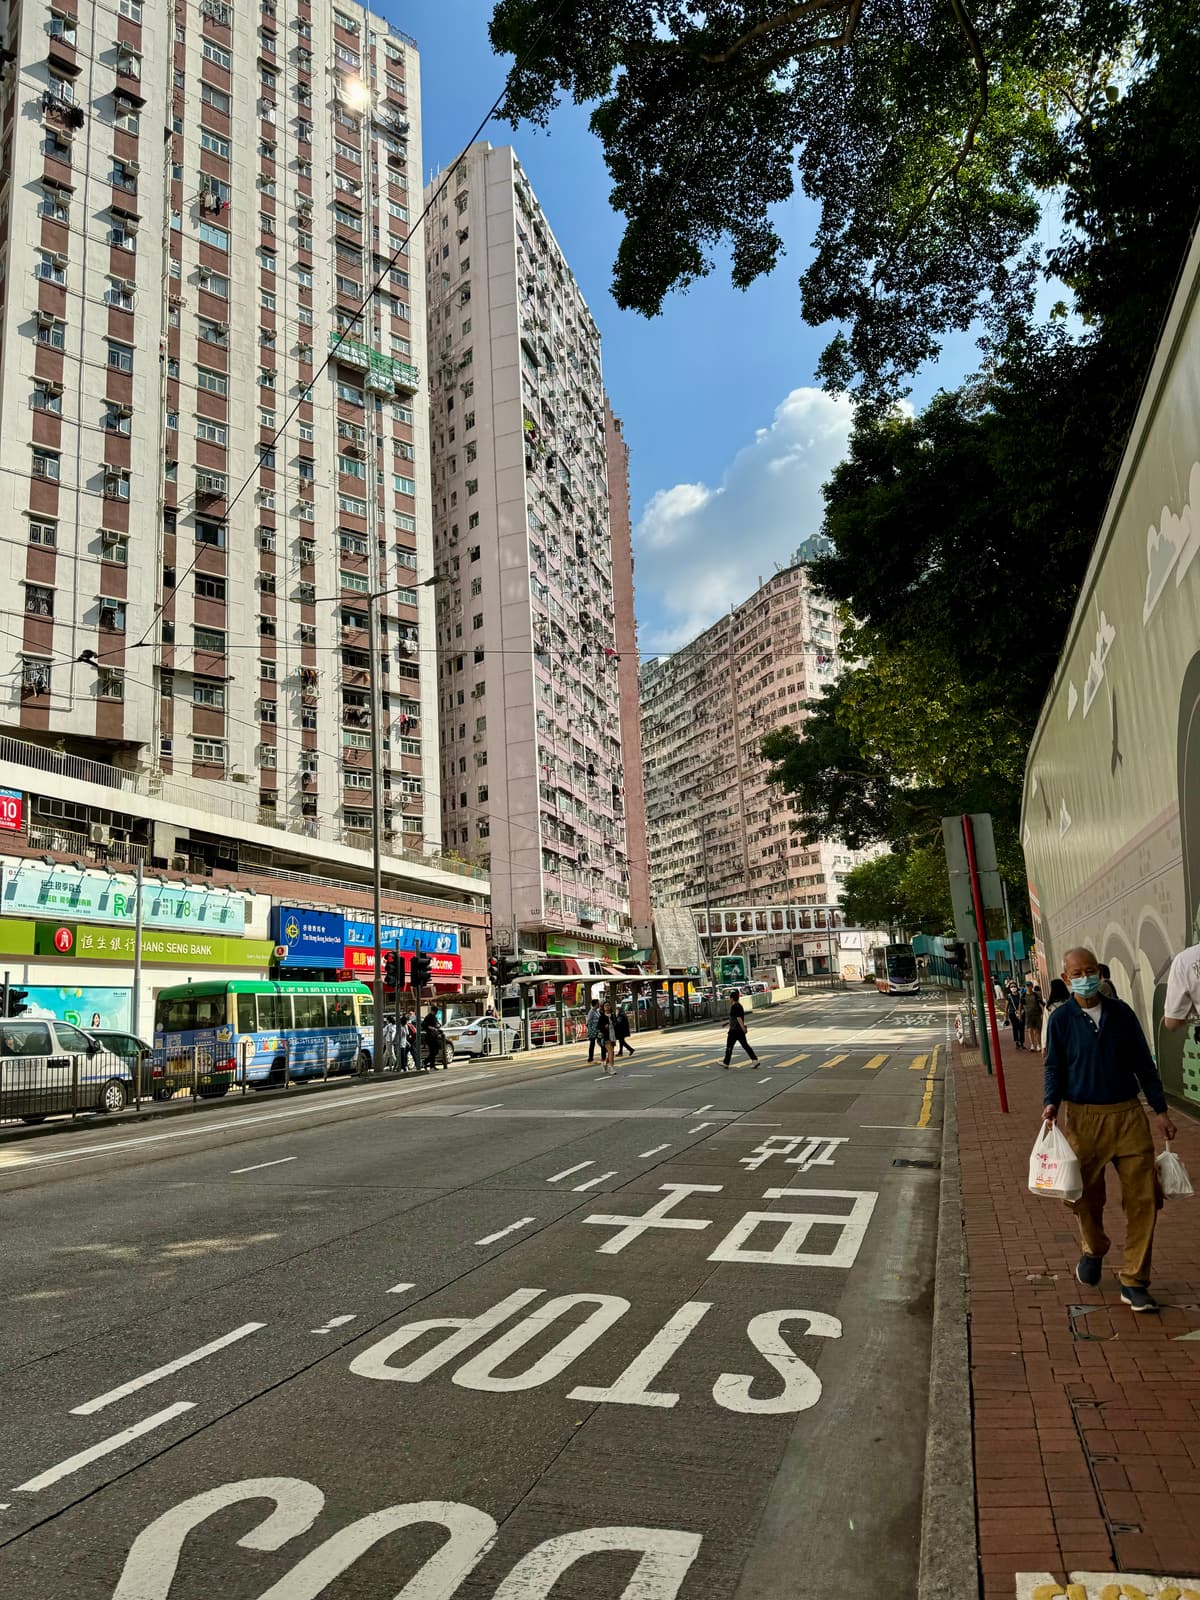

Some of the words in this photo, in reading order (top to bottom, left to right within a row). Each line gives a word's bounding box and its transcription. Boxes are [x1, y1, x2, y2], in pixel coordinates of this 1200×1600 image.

[80, 934, 136, 953] 恒生銀行
[141, 941, 164, 953] HANG
[166, 942, 188, 954] SENG
[190, 943, 212, 956] BANK
[348, 1287, 843, 1415] STOP
